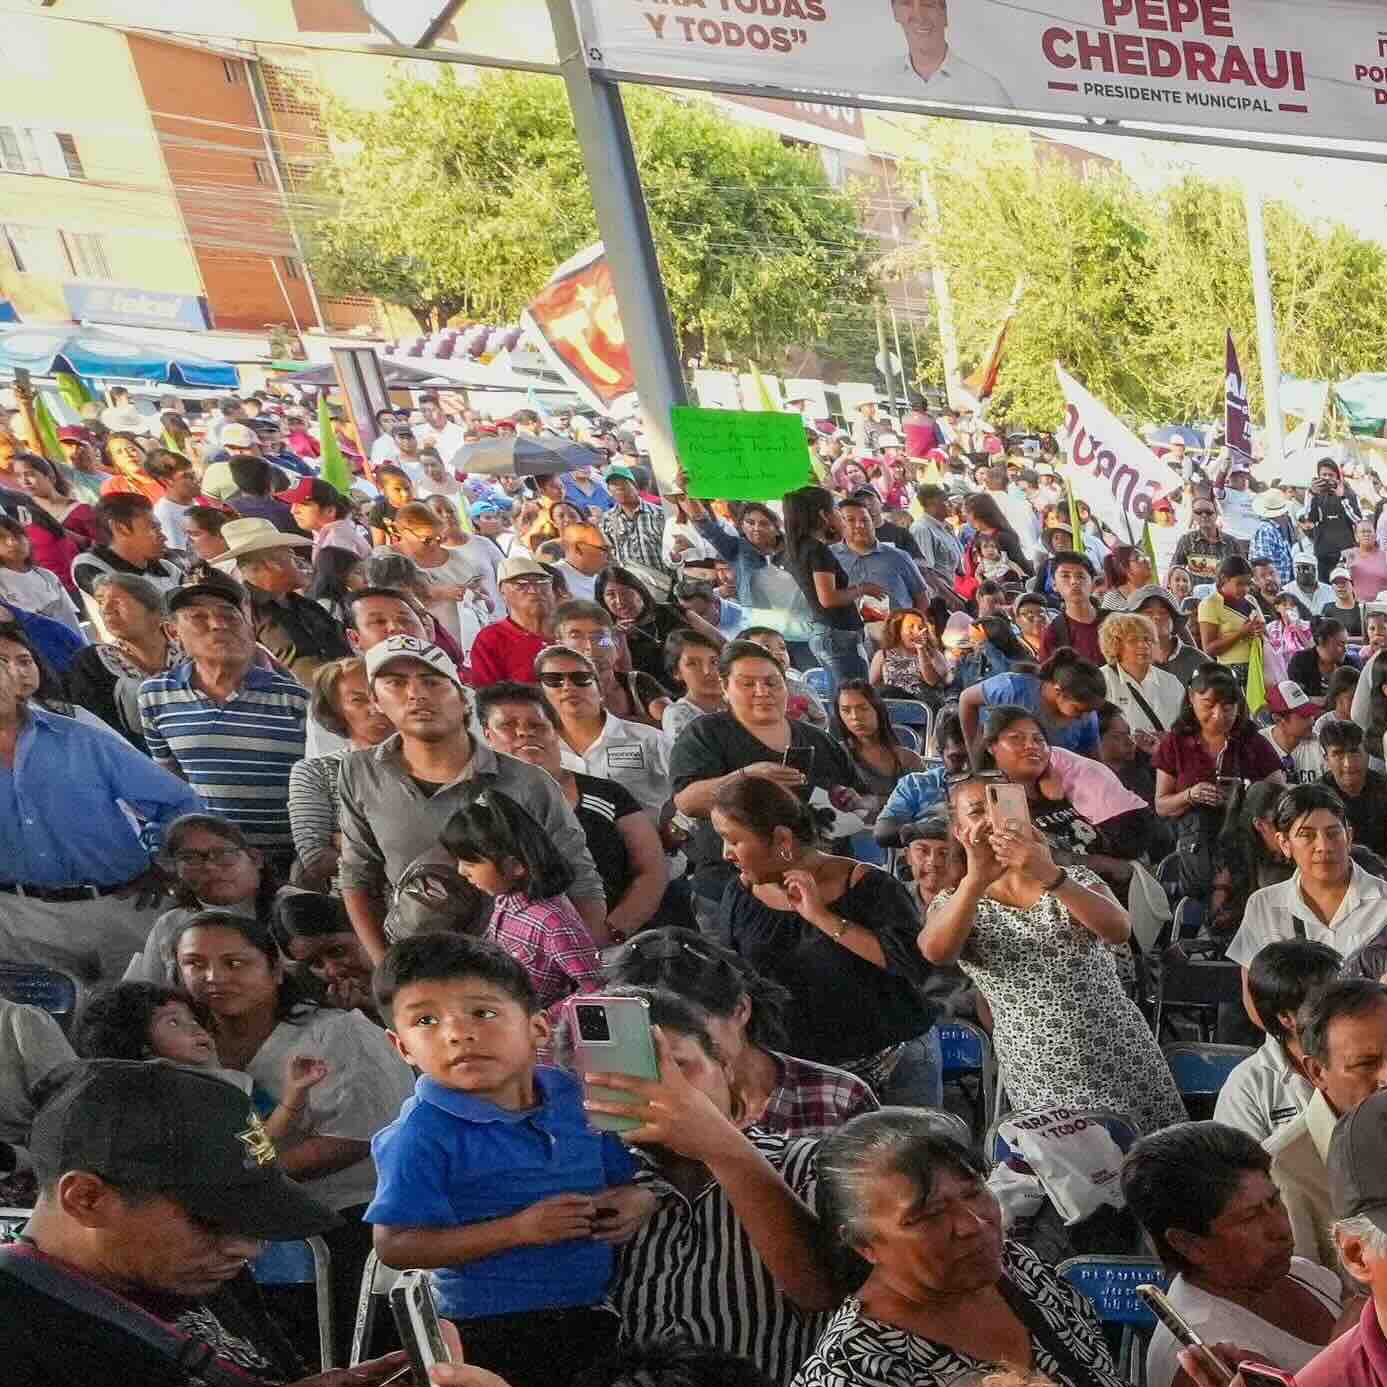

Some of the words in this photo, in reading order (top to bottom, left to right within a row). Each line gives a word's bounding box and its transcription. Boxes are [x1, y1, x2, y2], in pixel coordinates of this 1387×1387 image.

[645, 14, 665, 40] Y
[1101, 0, 1234, 38] PEPE
[1041, 27, 1306, 91] CHEDRAUI
[1083, 82, 1182, 104] PRESIDENTE
[1186, 91, 1273, 113] MUNICIPAL
